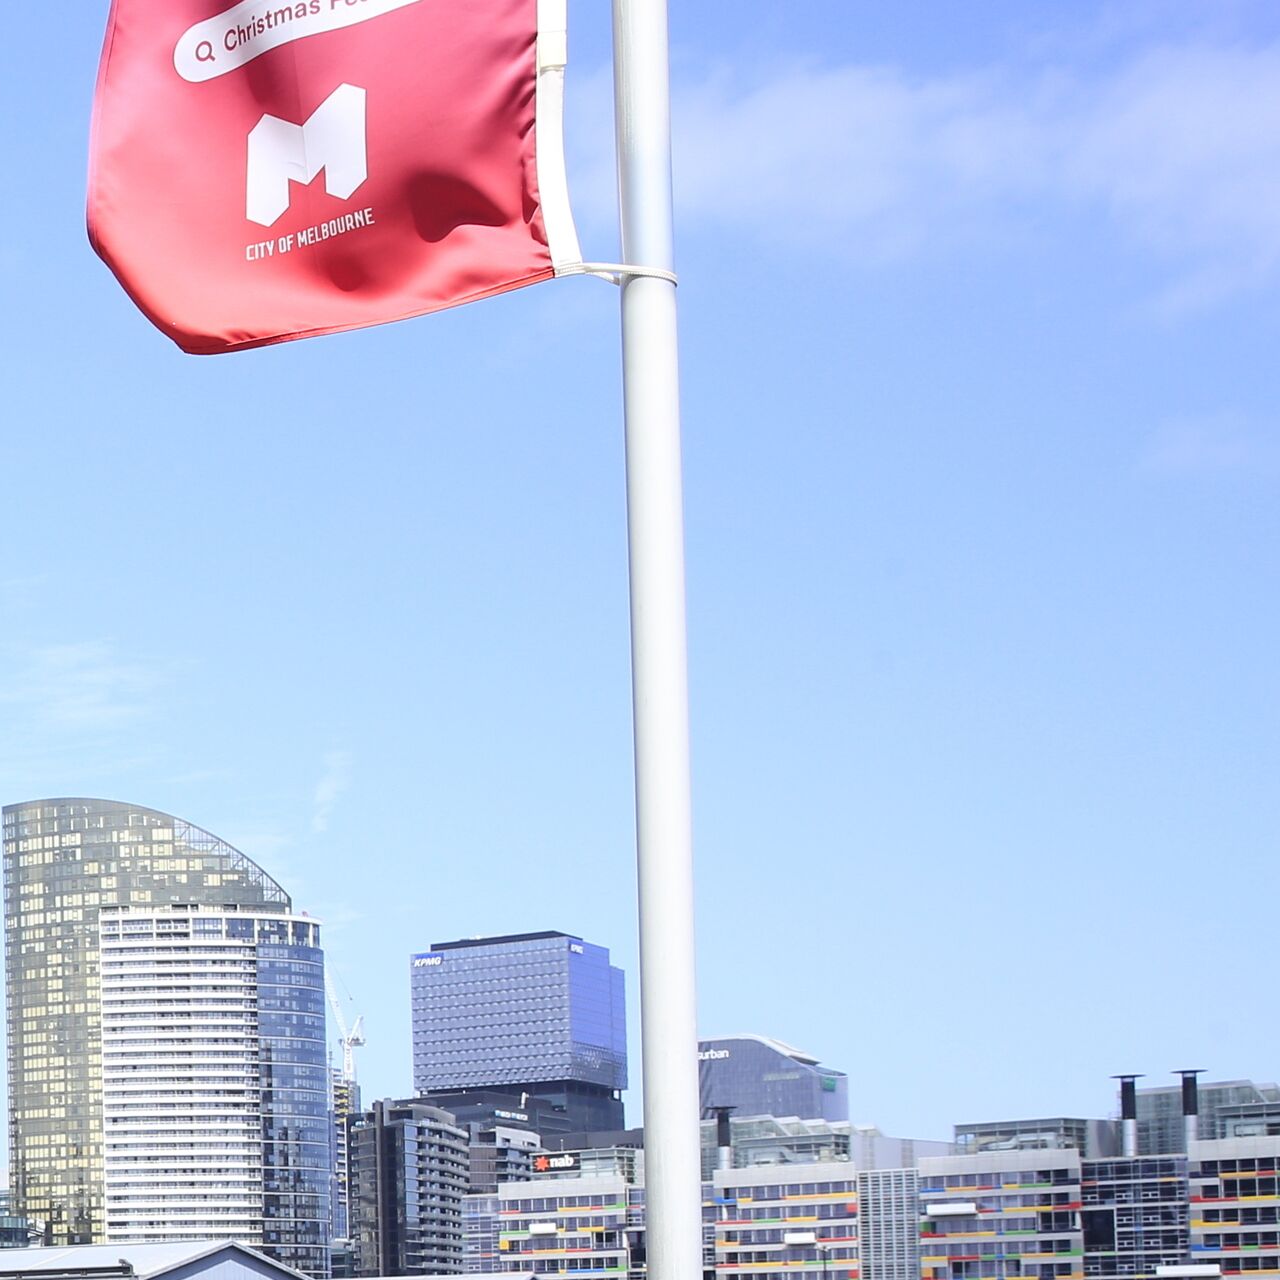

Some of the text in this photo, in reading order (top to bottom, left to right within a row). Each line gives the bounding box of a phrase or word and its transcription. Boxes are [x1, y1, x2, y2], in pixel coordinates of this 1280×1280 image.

[223, 0, 321, 52] Christmas
[246, 207, 375, 261] CITY OF MELBOURNE
[414, 956, 441, 967] KPMG
[549, 1154, 574, 1168] nab
